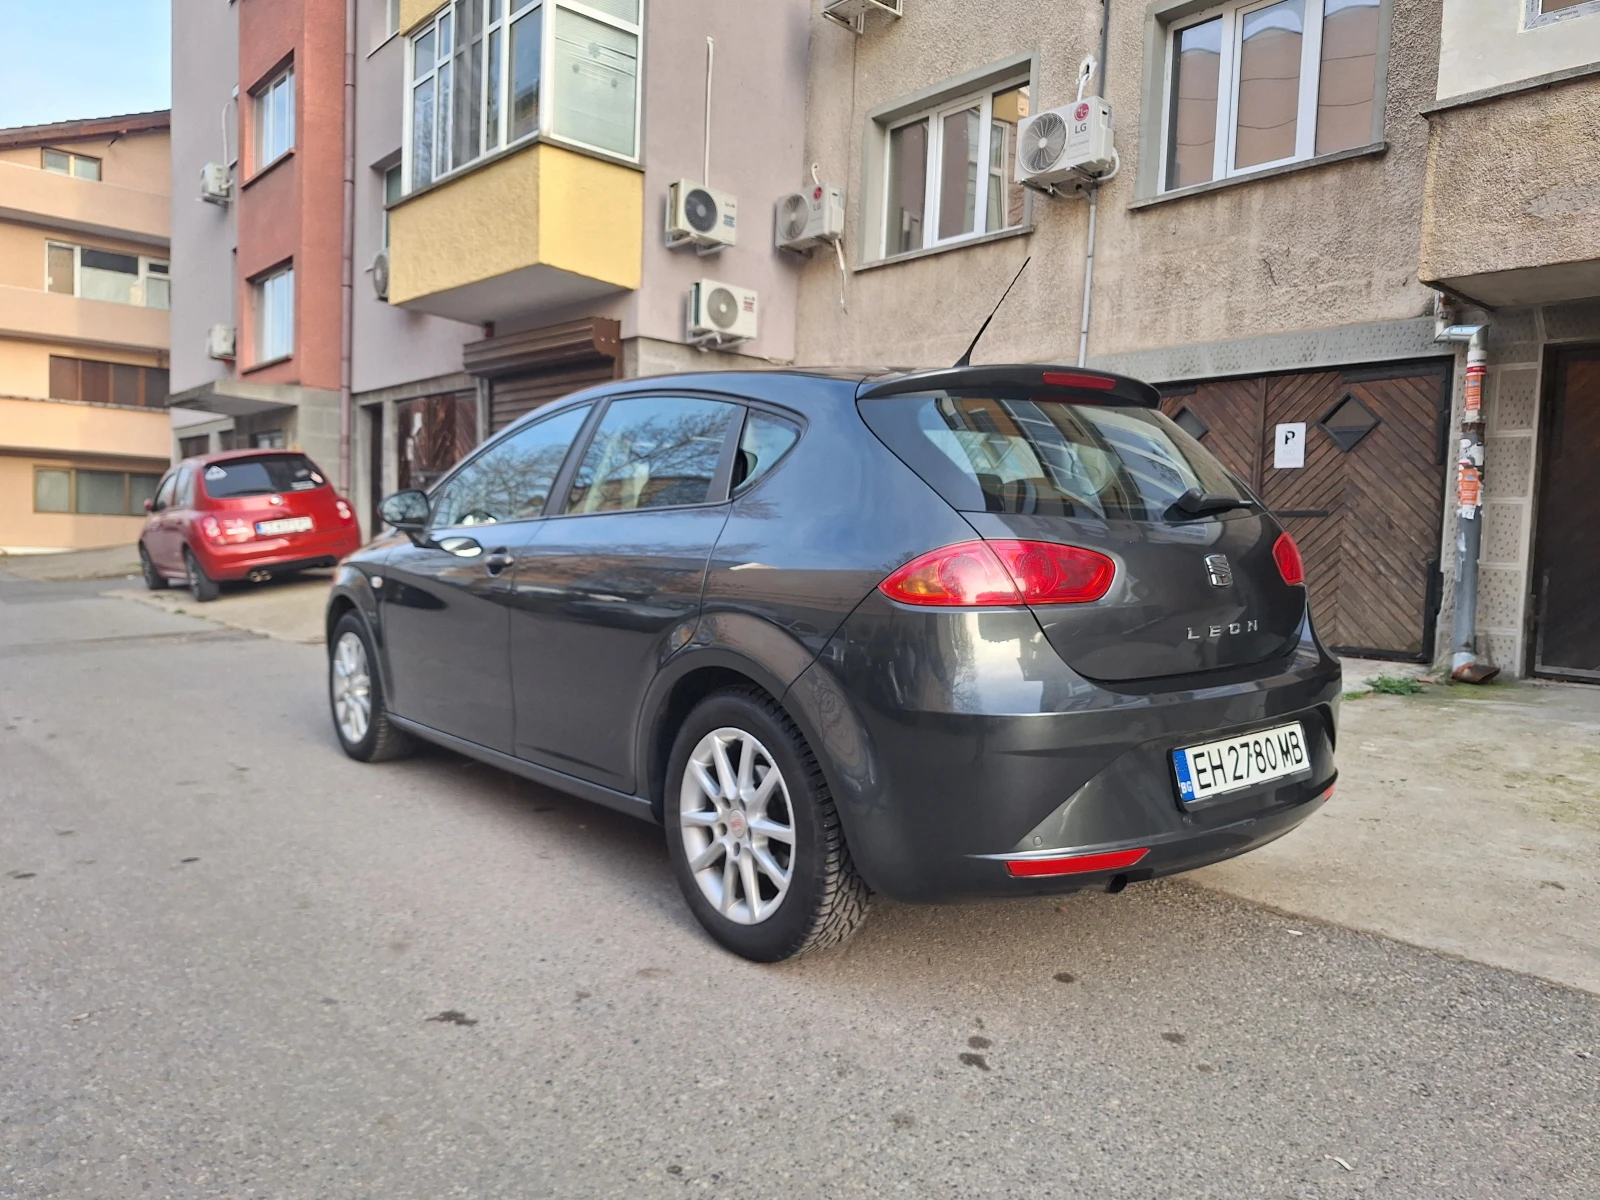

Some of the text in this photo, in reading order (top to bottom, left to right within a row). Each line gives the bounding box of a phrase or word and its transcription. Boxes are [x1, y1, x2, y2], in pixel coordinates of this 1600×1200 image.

[1075, 123, 1087, 134] LG
[1187, 619, 1258, 640] LEON
[1181, 781, 1193, 794] BG
